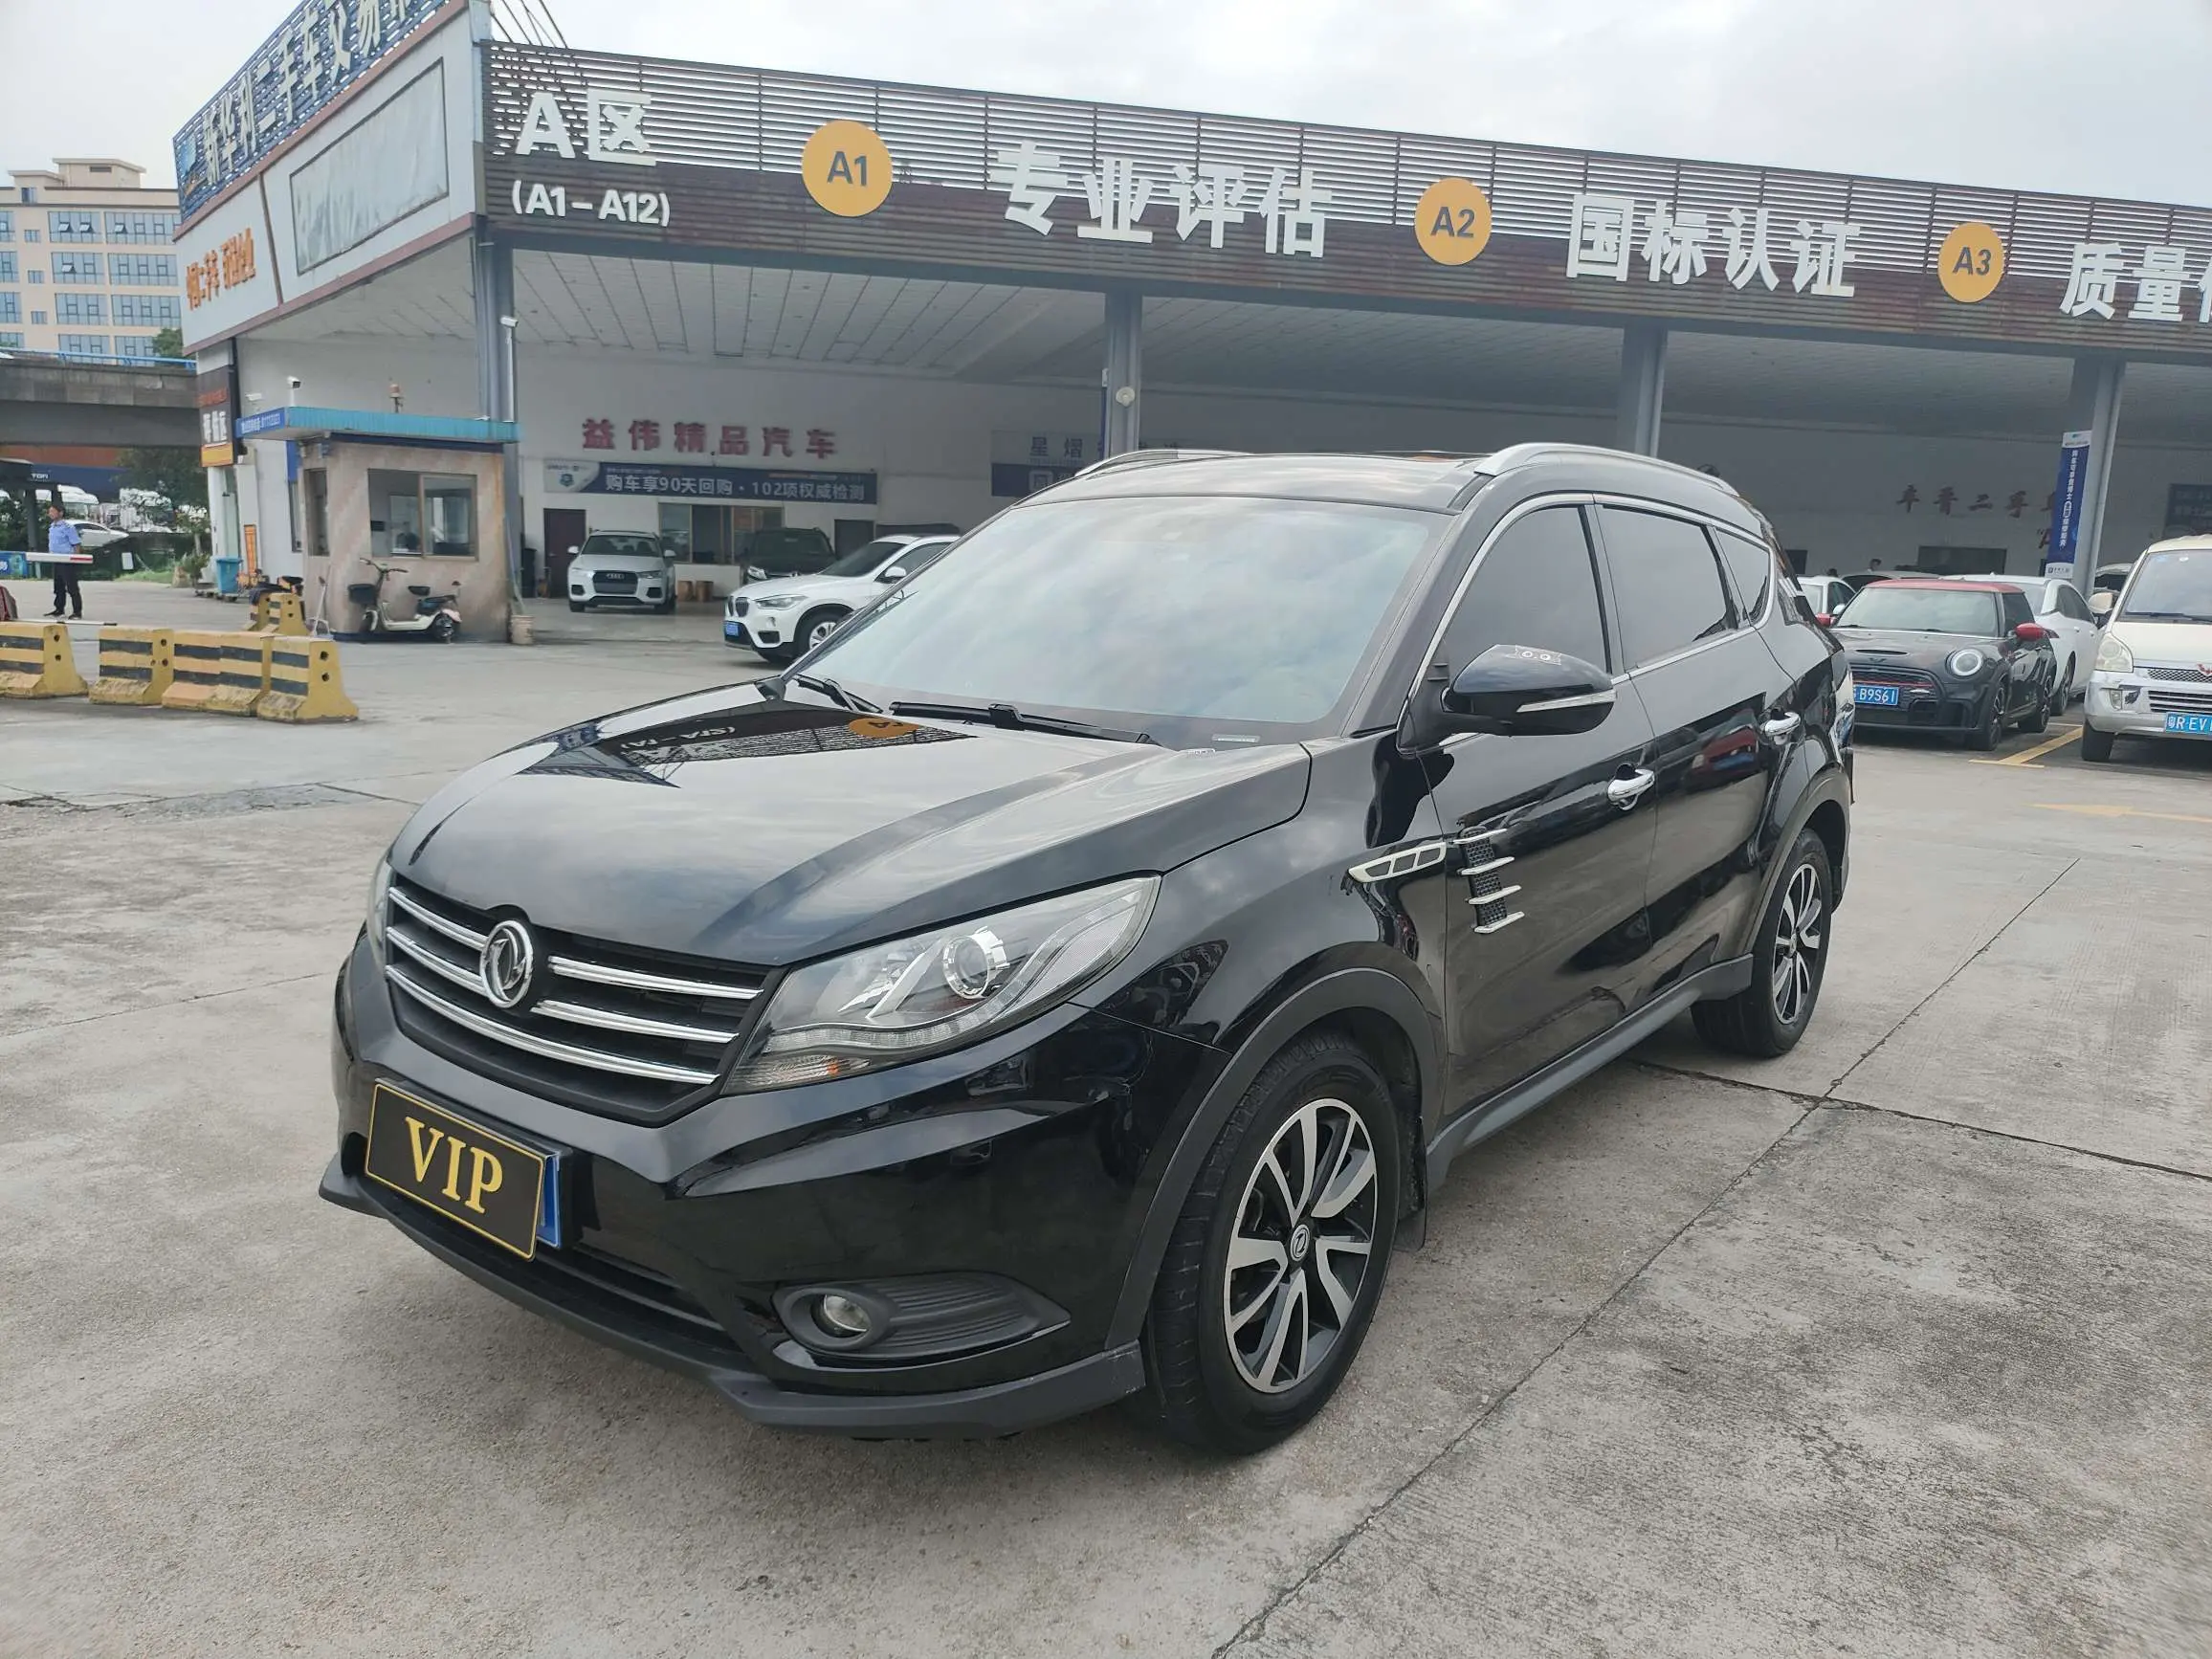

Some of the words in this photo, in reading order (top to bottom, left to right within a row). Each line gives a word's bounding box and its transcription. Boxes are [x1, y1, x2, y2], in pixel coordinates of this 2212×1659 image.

[202, 0, 407, 186] 新华利二手车交易
[516, 88, 657, 166] A区
[827, 150, 869, 187] A1
[988, 140, 1333, 258] 专业评估
[1429, 205, 1476, 239] A2
[1565, 193, 1861, 299] 国标认证
[1952, 245, 1993, 277] A3
[582, 418, 838, 459] 益伟精品汽车
[405, 1116, 503, 1214] VIP
